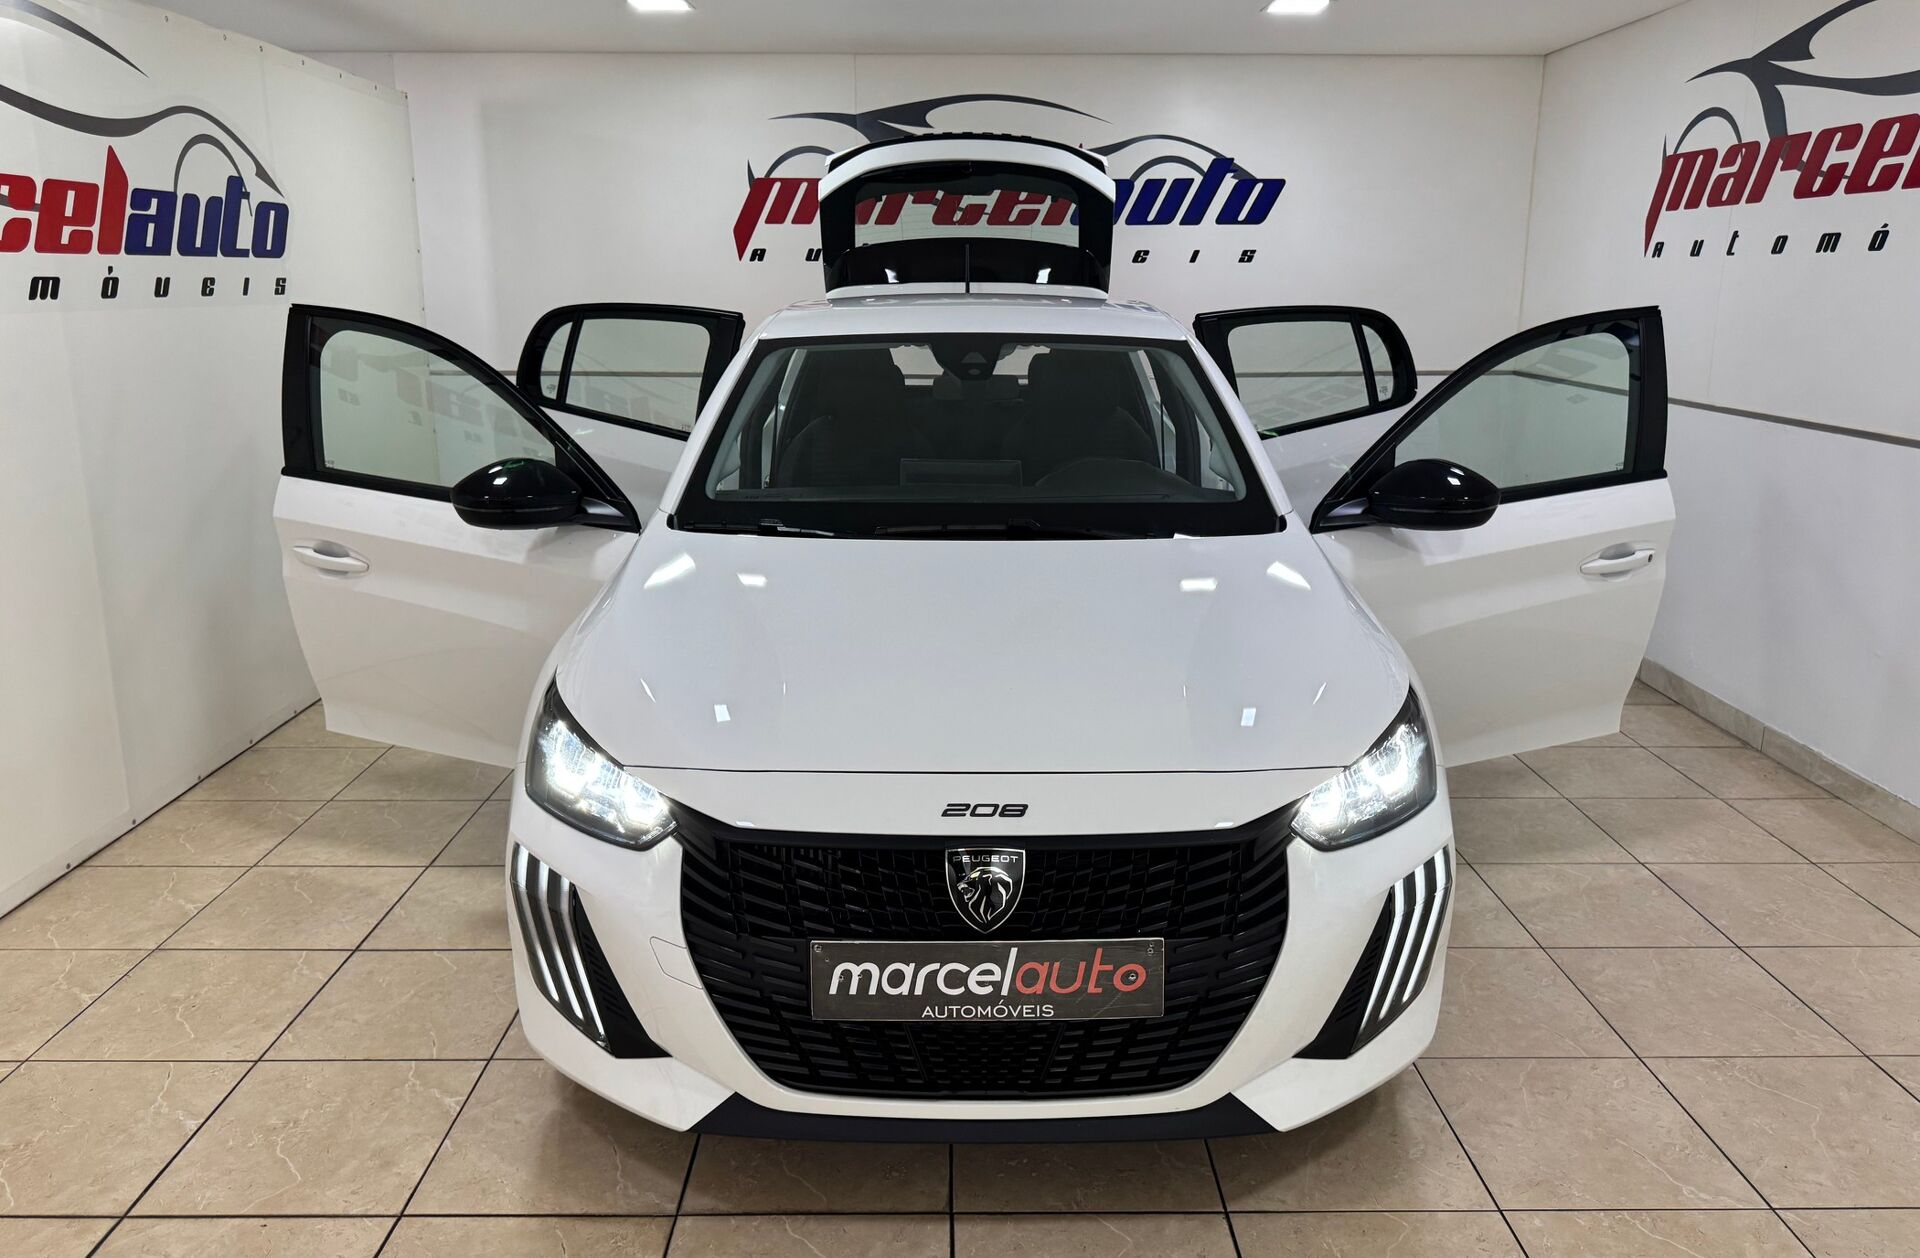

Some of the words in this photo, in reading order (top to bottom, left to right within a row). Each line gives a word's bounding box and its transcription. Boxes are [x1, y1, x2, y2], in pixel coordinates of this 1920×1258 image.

[941, 803, 1029, 818] 208
[953, 854, 1019, 864] PEUGEOT
[828, 946, 1147, 996] marcelauto
[921, 999, 1054, 1019] AUTOMÓVEIS
